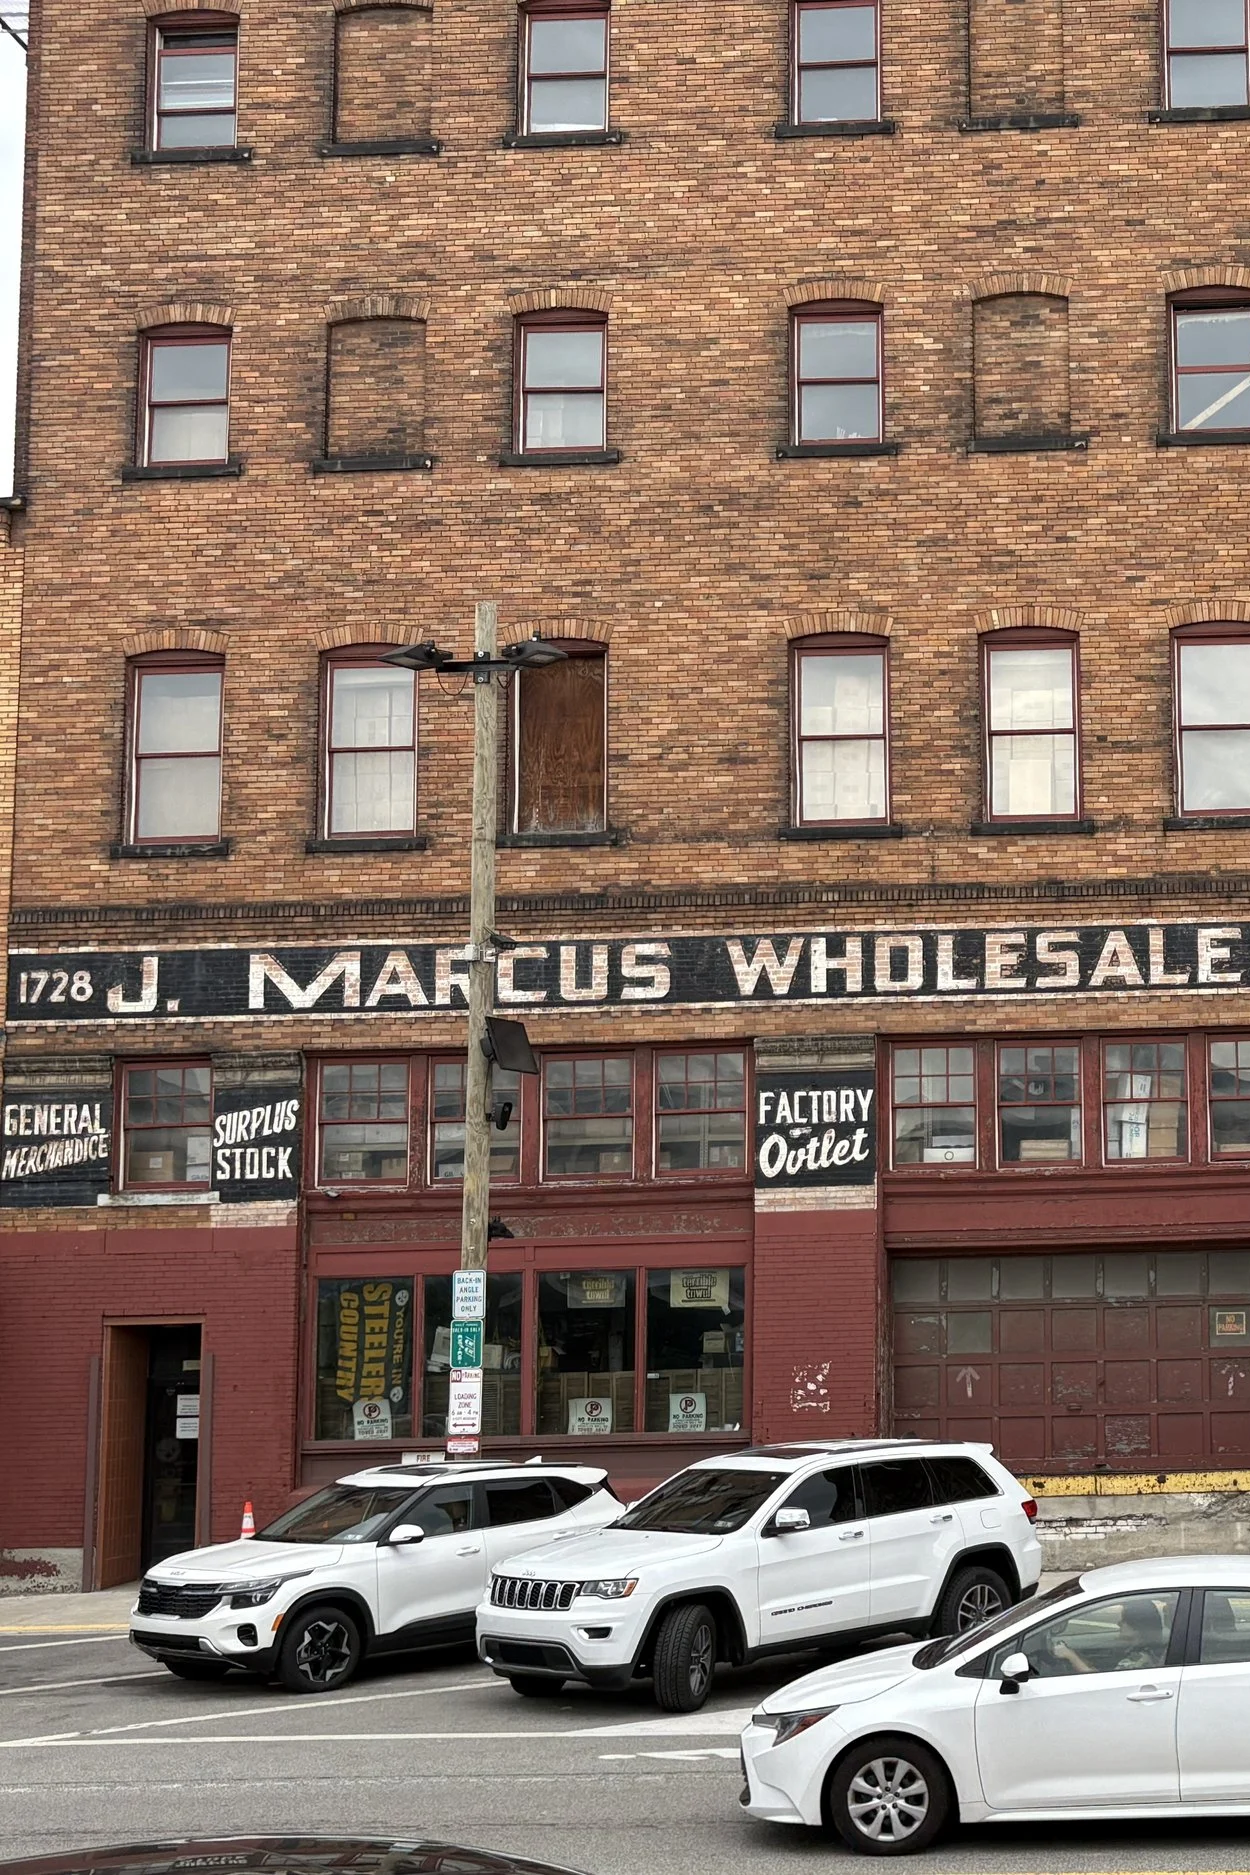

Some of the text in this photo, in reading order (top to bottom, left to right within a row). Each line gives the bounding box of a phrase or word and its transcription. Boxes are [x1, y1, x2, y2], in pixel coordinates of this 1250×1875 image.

[20, 970, 94, 1004] 1728
[107, 956, 180, 1013] J.
[248, 942, 672, 1009] MARCUS
[726, 927, 1242, 997] WHOLESALE
[758, 1088, 874, 1124] FACTORY
[4, 1103, 108, 1137] GENERAL
[213, 1099, 300, 1148] SURPLUS
[2, 1134, 109, 1181] MERCHANDICE
[759, 1128, 870, 1178] Outlet
[216, 1147, 293, 1180] STOCK
[457, 1277, 482, 1285] BACK-IN
[682, 1275, 718, 1288] terrible
[459, 1286, 479, 1294] ANGLE
[686, 1288, 712, 1299] towel
[460, 1305, 477, 1313] ONLY
[1225, 1315, 1236, 1324] NO
[1218, 1323, 1244, 1332] PARKING
[336, 1291, 360, 1402] COUNTRY
[392, 1368, 402, 1385] IN
[451, 1370, 461, 1382] NO
[457, 1401, 472, 1409] ZONE
[416, 1454, 431, 1463] FIRE
